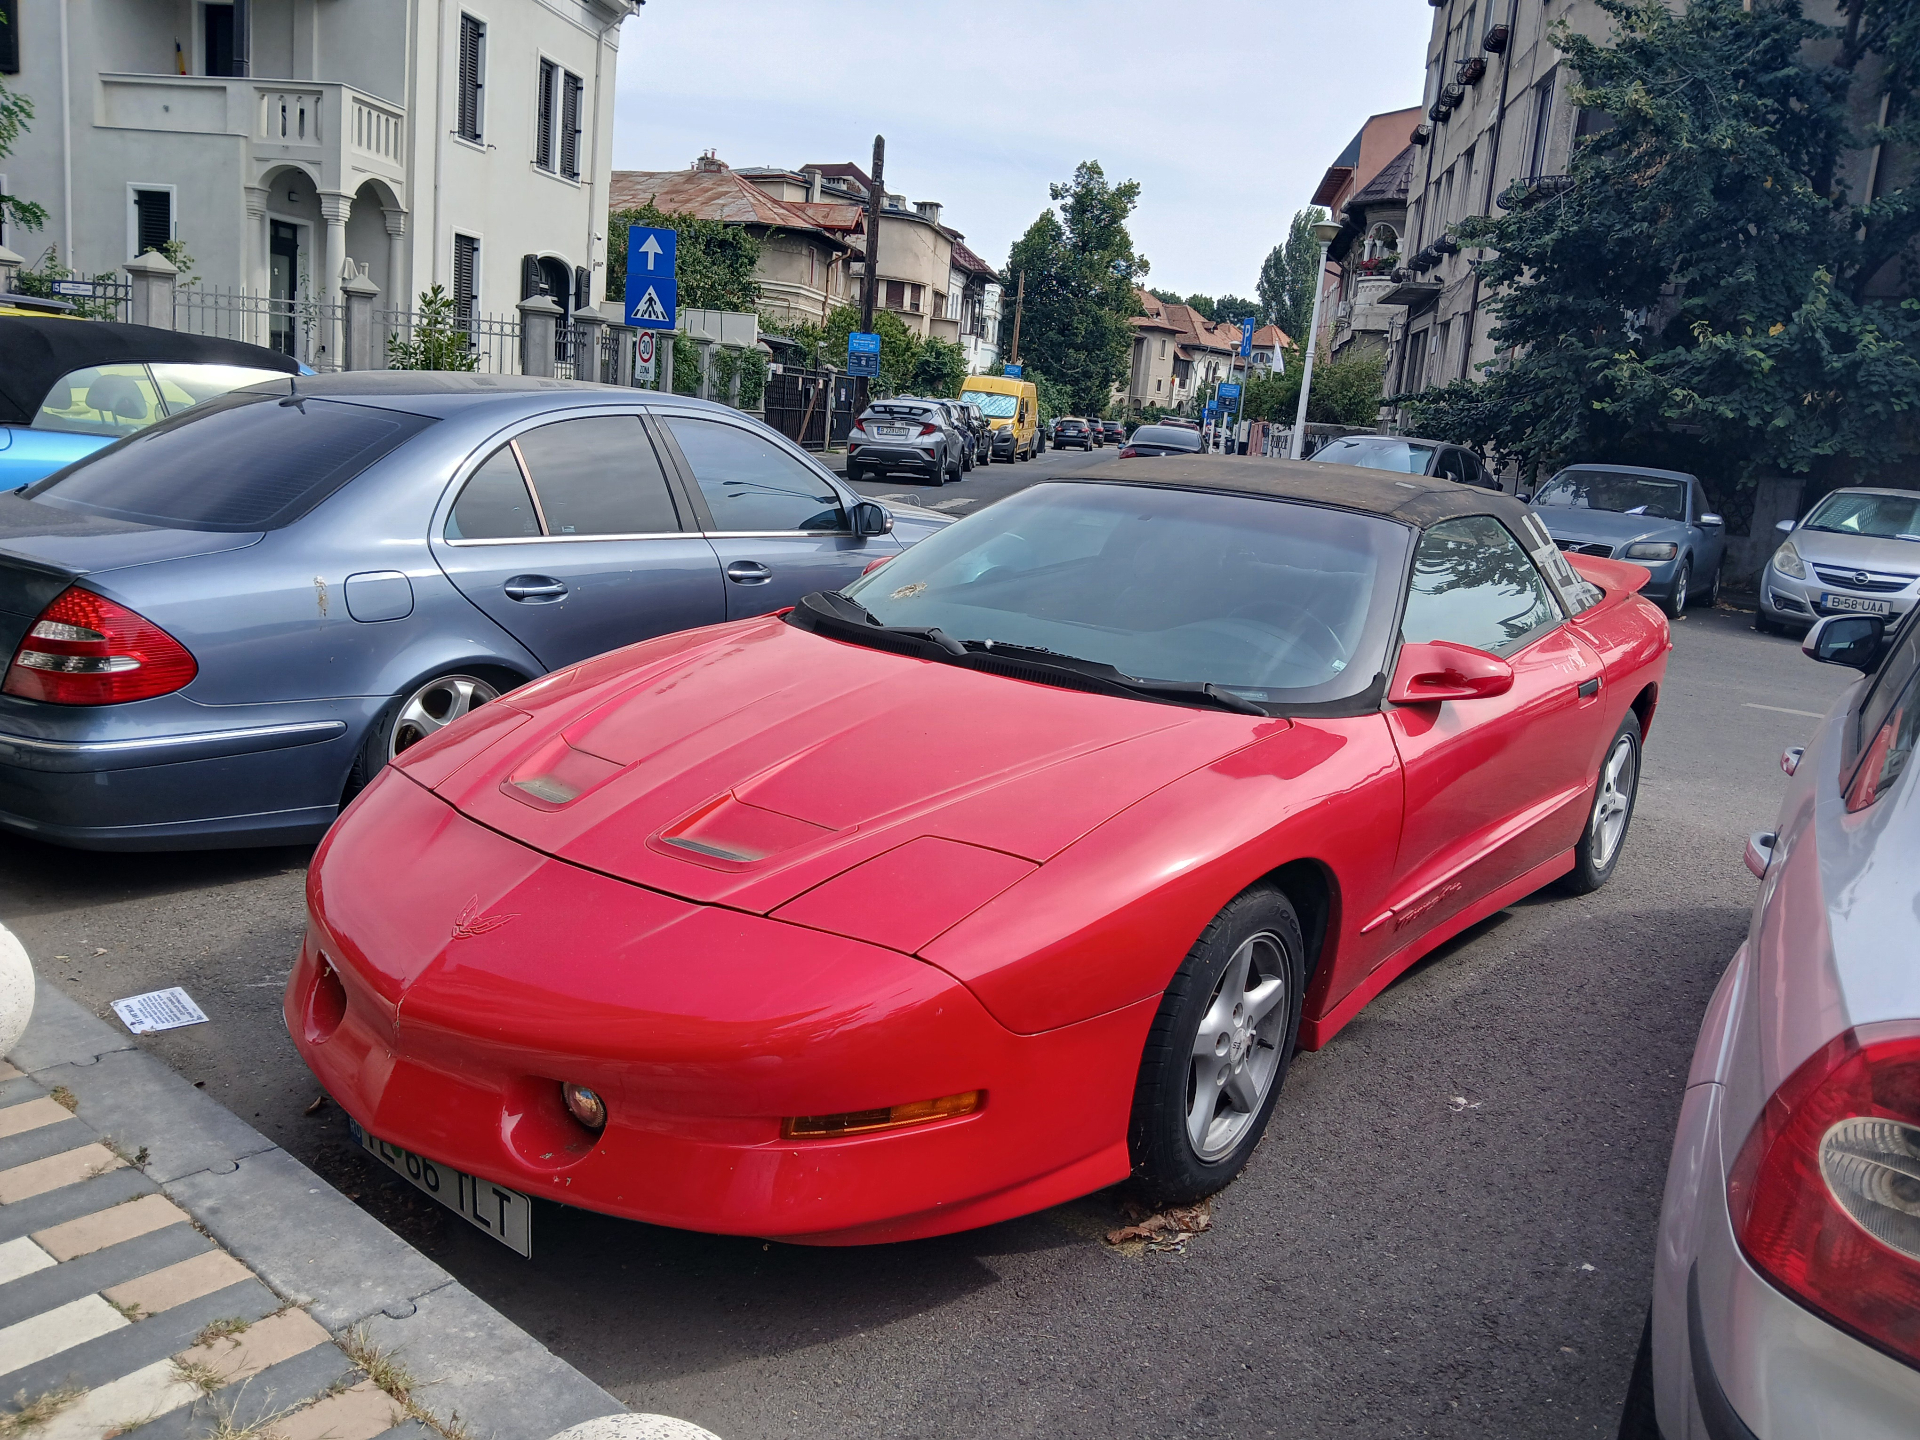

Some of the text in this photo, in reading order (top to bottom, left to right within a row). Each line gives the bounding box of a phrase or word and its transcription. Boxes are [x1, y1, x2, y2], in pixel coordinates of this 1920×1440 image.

[52, 283, 60, 292] 15
[1244, 325, 1251, 346] P
[641, 340, 650, 354] 30
[639, 365, 650, 374] ZONA
[1831, 597, 1841, 607] B
[1843, 598, 1858, 609] 58
[1861, 601, 1884, 613] UAA
